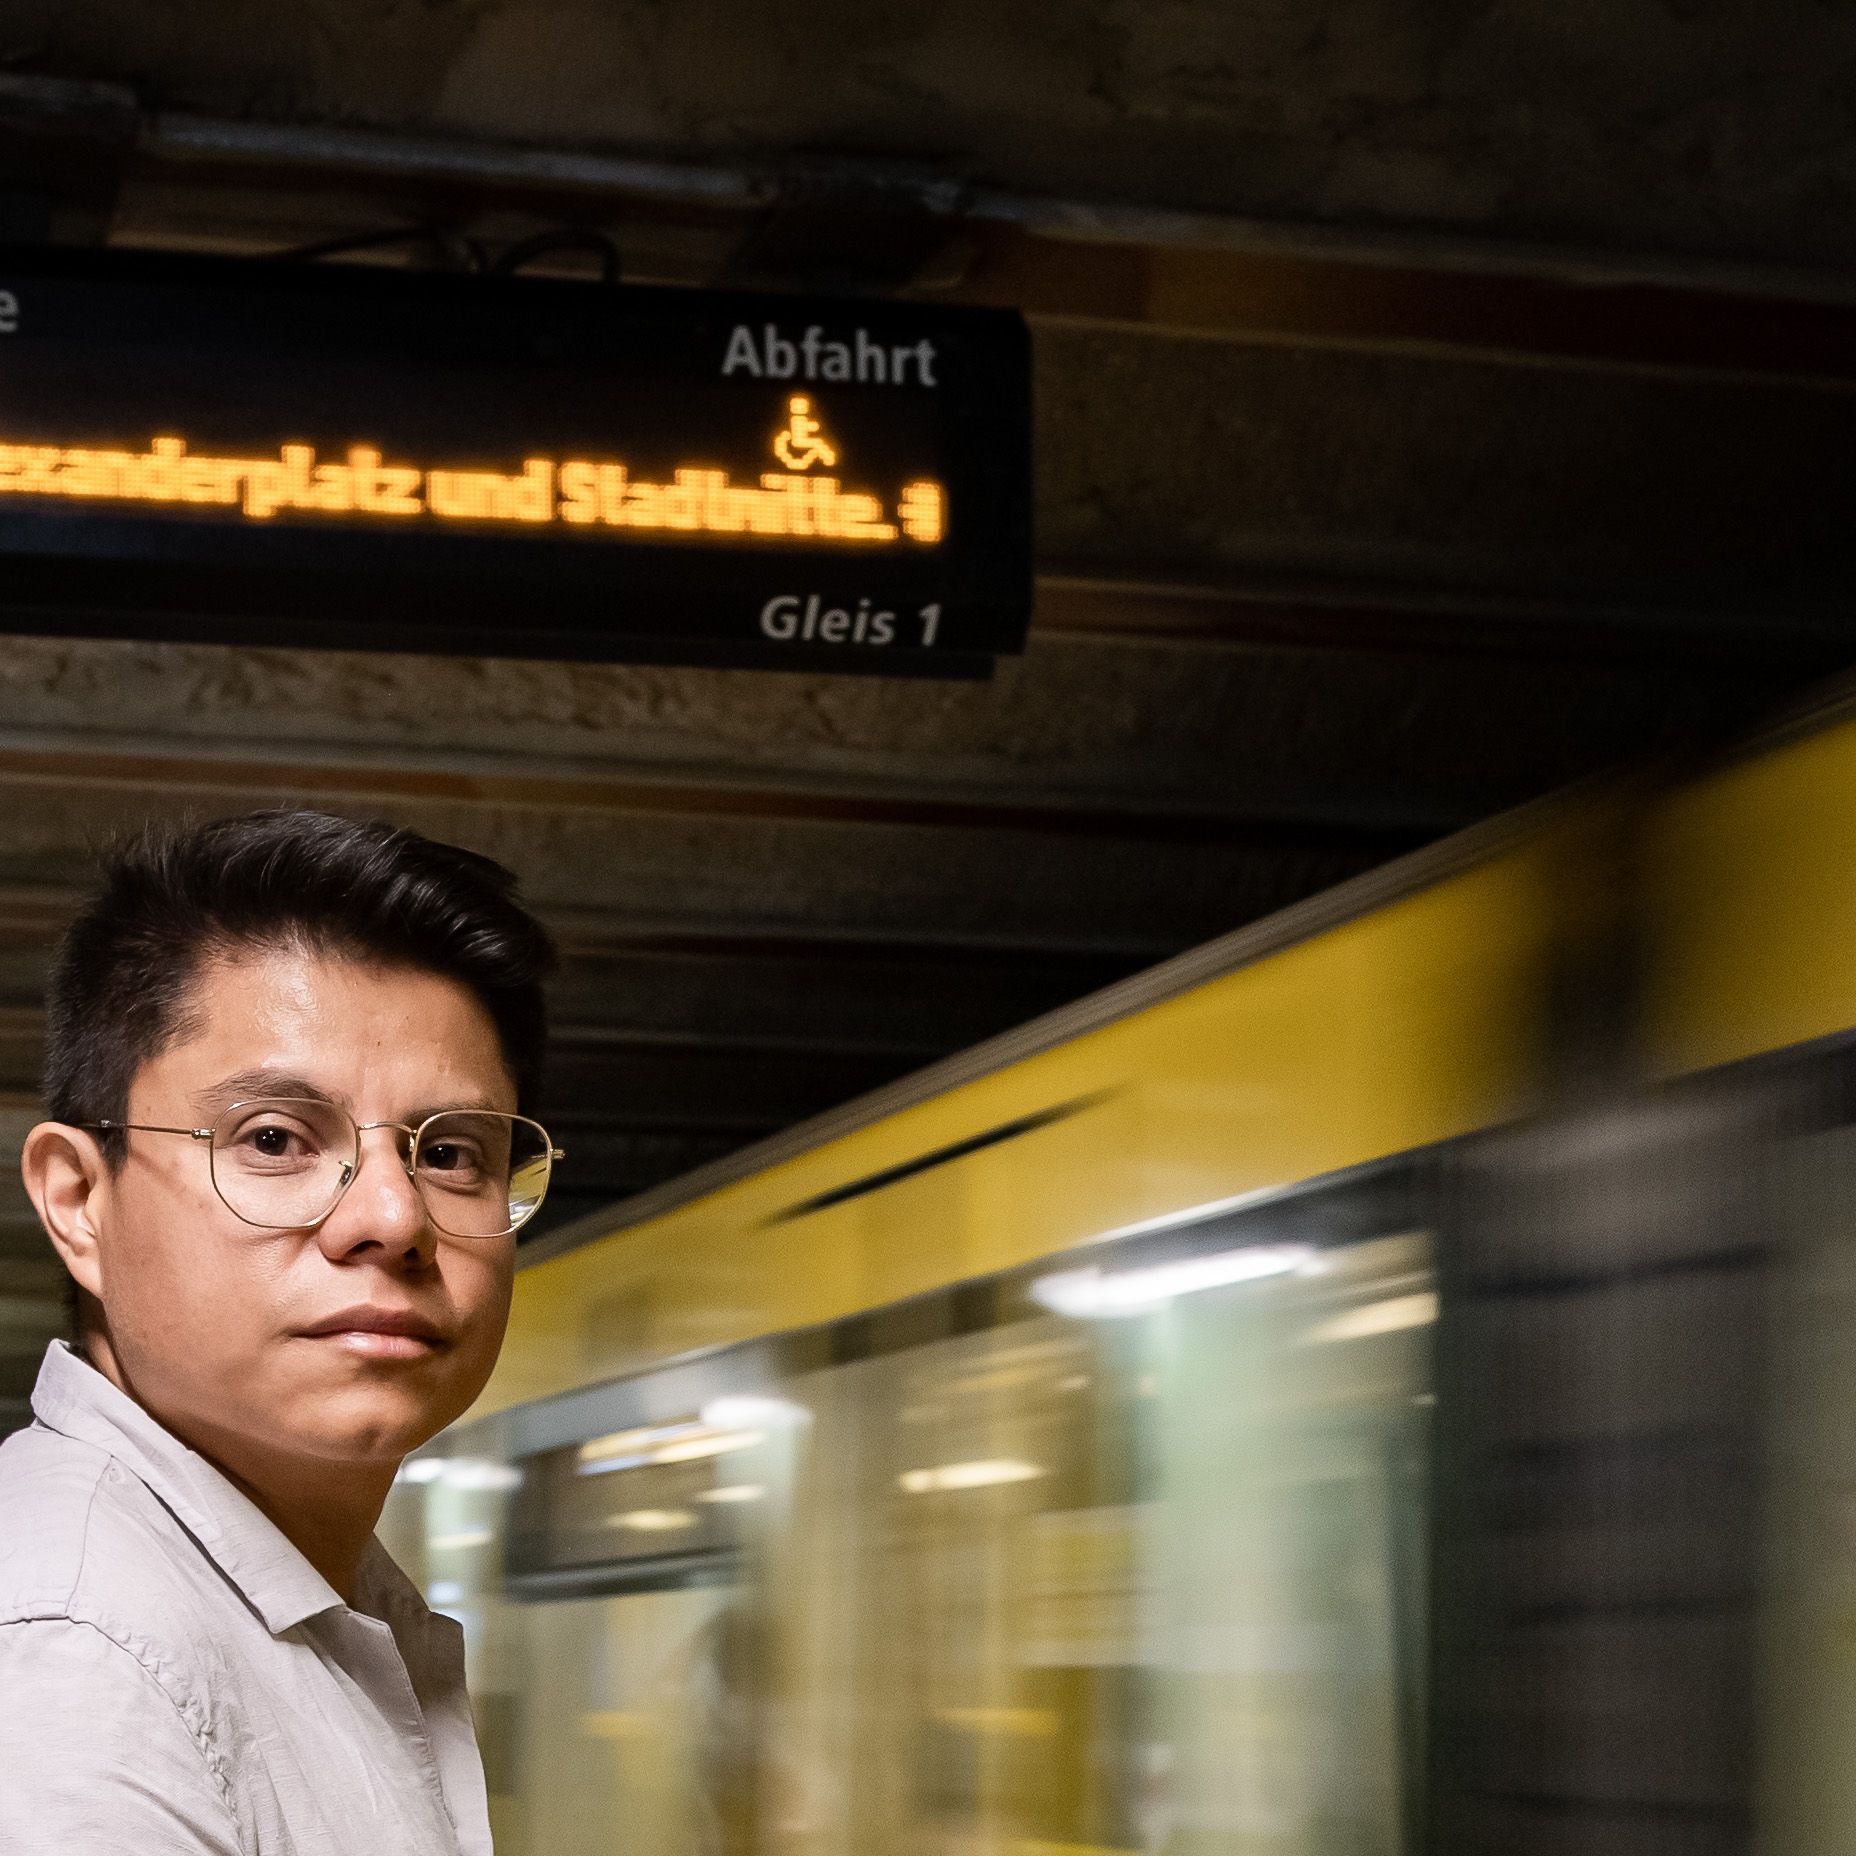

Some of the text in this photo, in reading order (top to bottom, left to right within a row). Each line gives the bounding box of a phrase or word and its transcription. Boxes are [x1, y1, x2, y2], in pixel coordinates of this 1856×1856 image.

[721, 323, 937, 388] Abfahrt
[425, 458, 554, 523] und
[760, 594, 943, 648] Gleis 1
